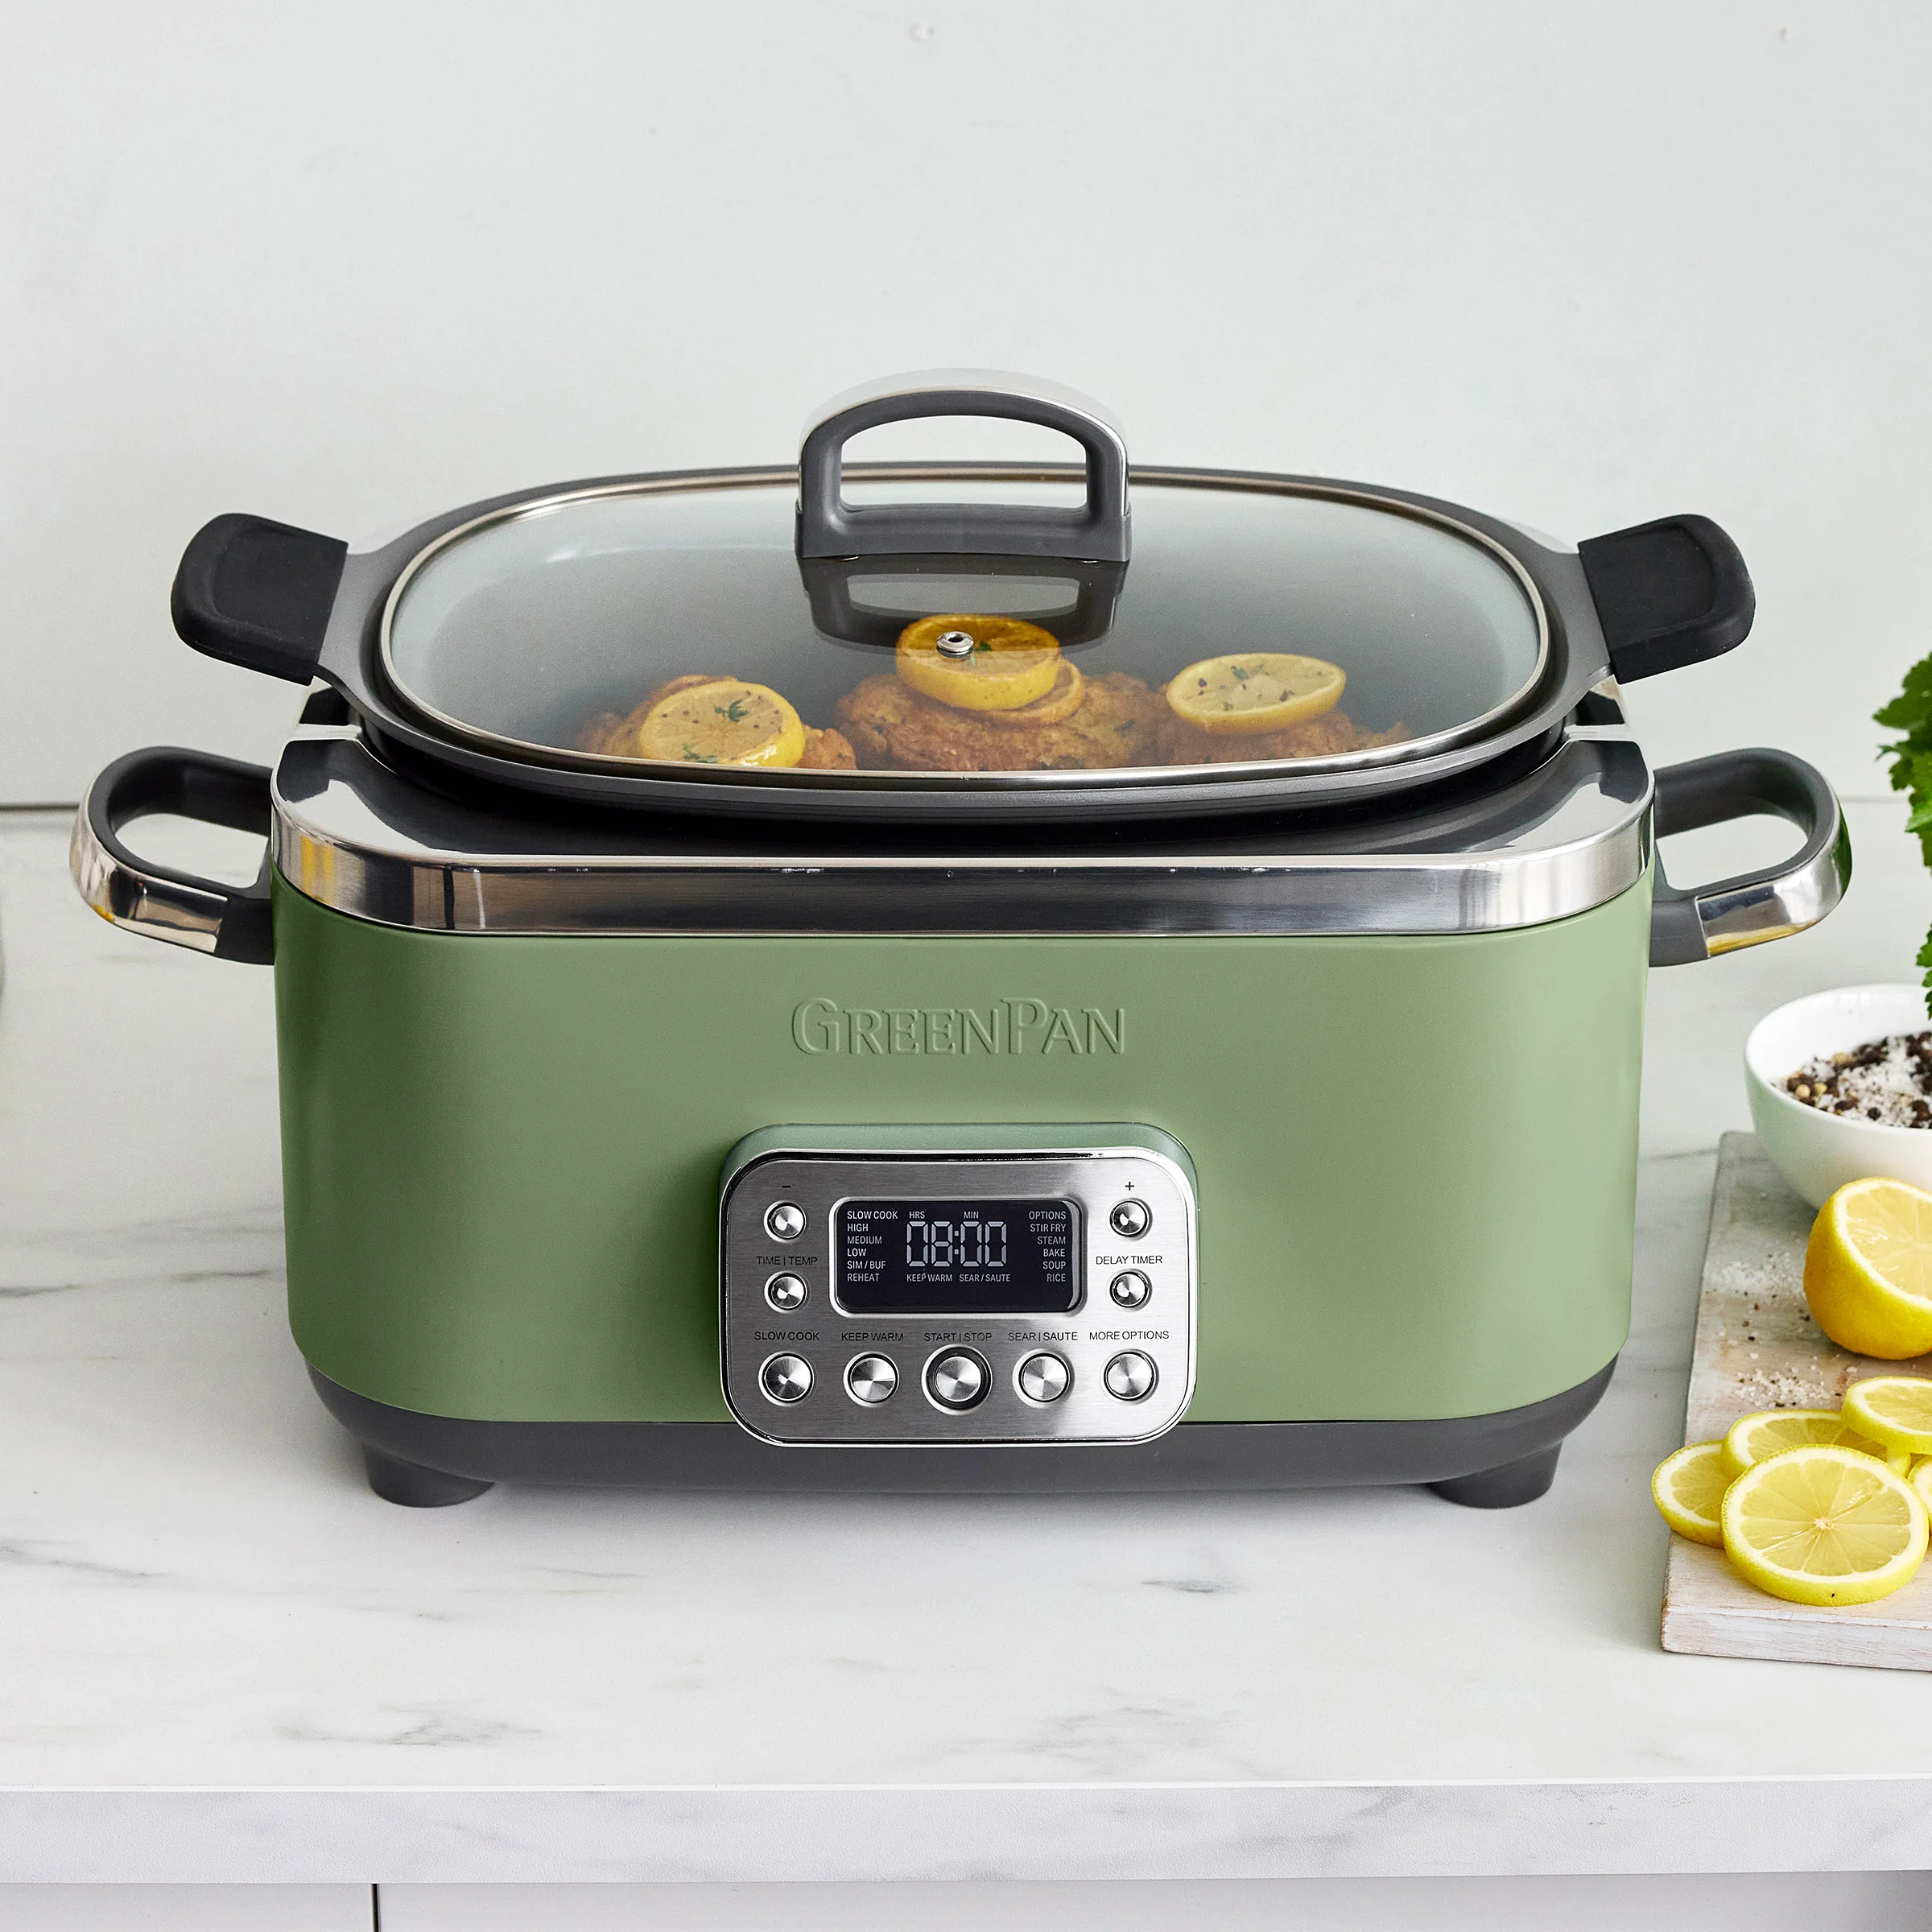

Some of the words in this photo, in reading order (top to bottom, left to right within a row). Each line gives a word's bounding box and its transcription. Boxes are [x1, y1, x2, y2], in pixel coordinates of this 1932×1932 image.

[847, 1211, 872, 1220] SLOW
[873, 1211, 898, 1220] COOK
[909, 1211, 926, 1220] HRS
[964, 1211, 979, 1220] MIN
[1028, 1211, 1067, 1220] OPTIONS
[847, 1223, 869, 1232] HIGH
[1030, 1224, 1049, 1232] STIR
[1051, 1224, 1067, 1232] FRY
[847, 1236, 882, 1245] MEDIUM
[906, 1220, 1007, 1267] 08:00
[1037, 1236, 1066, 1245] STEAM
[847, 1248, 867, 1257] LOW
[1043, 1249, 1066, 1257] BAKE
[757, 1256, 781, 1265] TIME
[789, 1257, 818, 1265] TEMP
[1096, 1256, 1129, 1265] DELAY
[1130, 1255, 1162, 1264] TIMER
[847, 1261, 863, 1269] SIM
[869, 1261, 886, 1269] BUF
[1042, 1261, 1067, 1269] SOUP
[847, 1273, 880, 1282] REHEAT
[906, 1274, 927, 1282] KEEP
[927, 1274, 953, 1282] WARM
[959, 1274, 980, 1282] SEAR
[985, 1274, 1011, 1282] SAUTE
[1046, 1274, 1067, 1282] RICE
[753, 1331, 786, 1341] SLOW
[787, 1331, 820, 1341] COOK
[841, 1332, 869, 1342] KEEP
[871, 1332, 904, 1342] WARM
[923, 1332, 956, 1342] START
[964, 1332, 993, 1342] STOP
[1008, 1332, 1036, 1341] SEAR
[1042, 1332, 1078, 1341] SAUTE
[1089, 1331, 1120, 1340] MORE
[1121, 1331, 1170, 1340] OPTIONS
